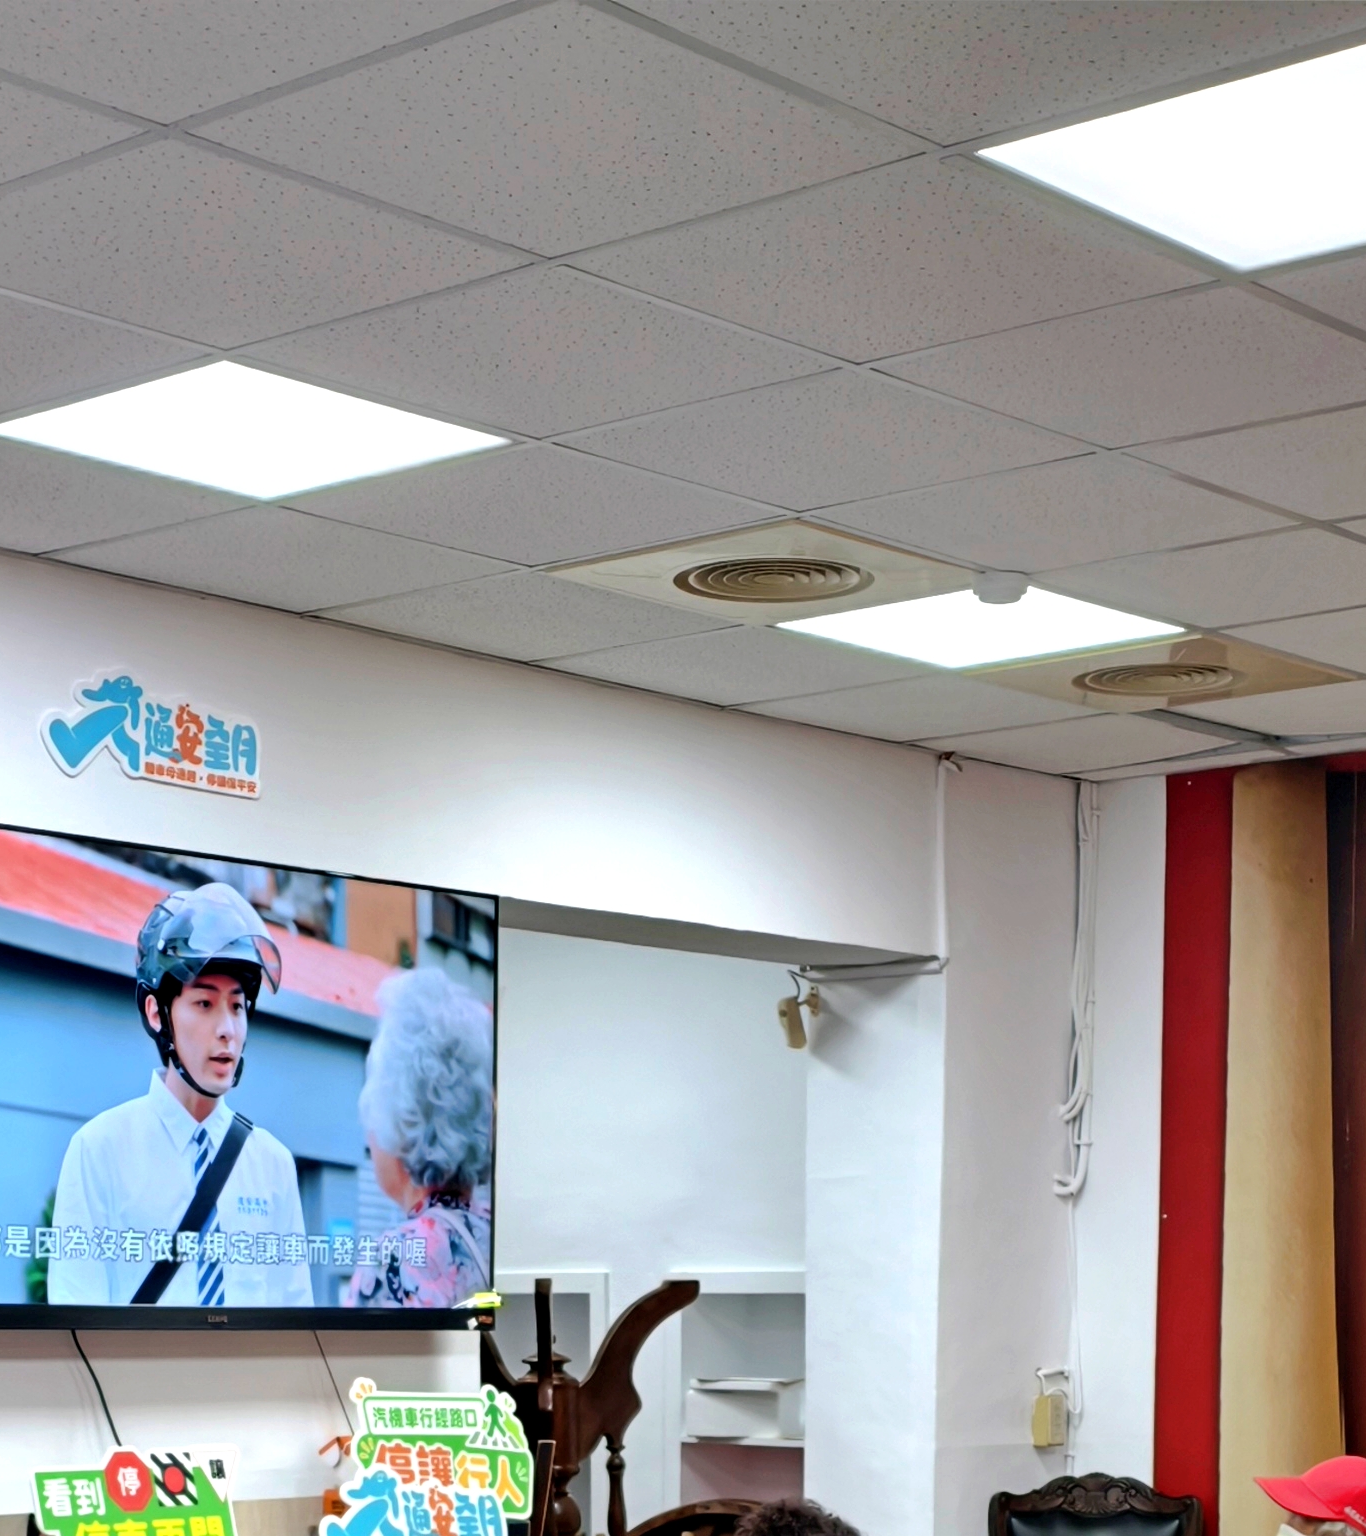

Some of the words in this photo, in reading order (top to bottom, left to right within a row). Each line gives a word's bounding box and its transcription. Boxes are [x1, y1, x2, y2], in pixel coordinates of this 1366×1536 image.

[372, 1405, 478, 1429] 汽機車行經路口
[42, 1477, 106, 1518] 看到
[117, 1468, 141, 1497] 停
[376, 1442, 524, 1508] 停讓行人
